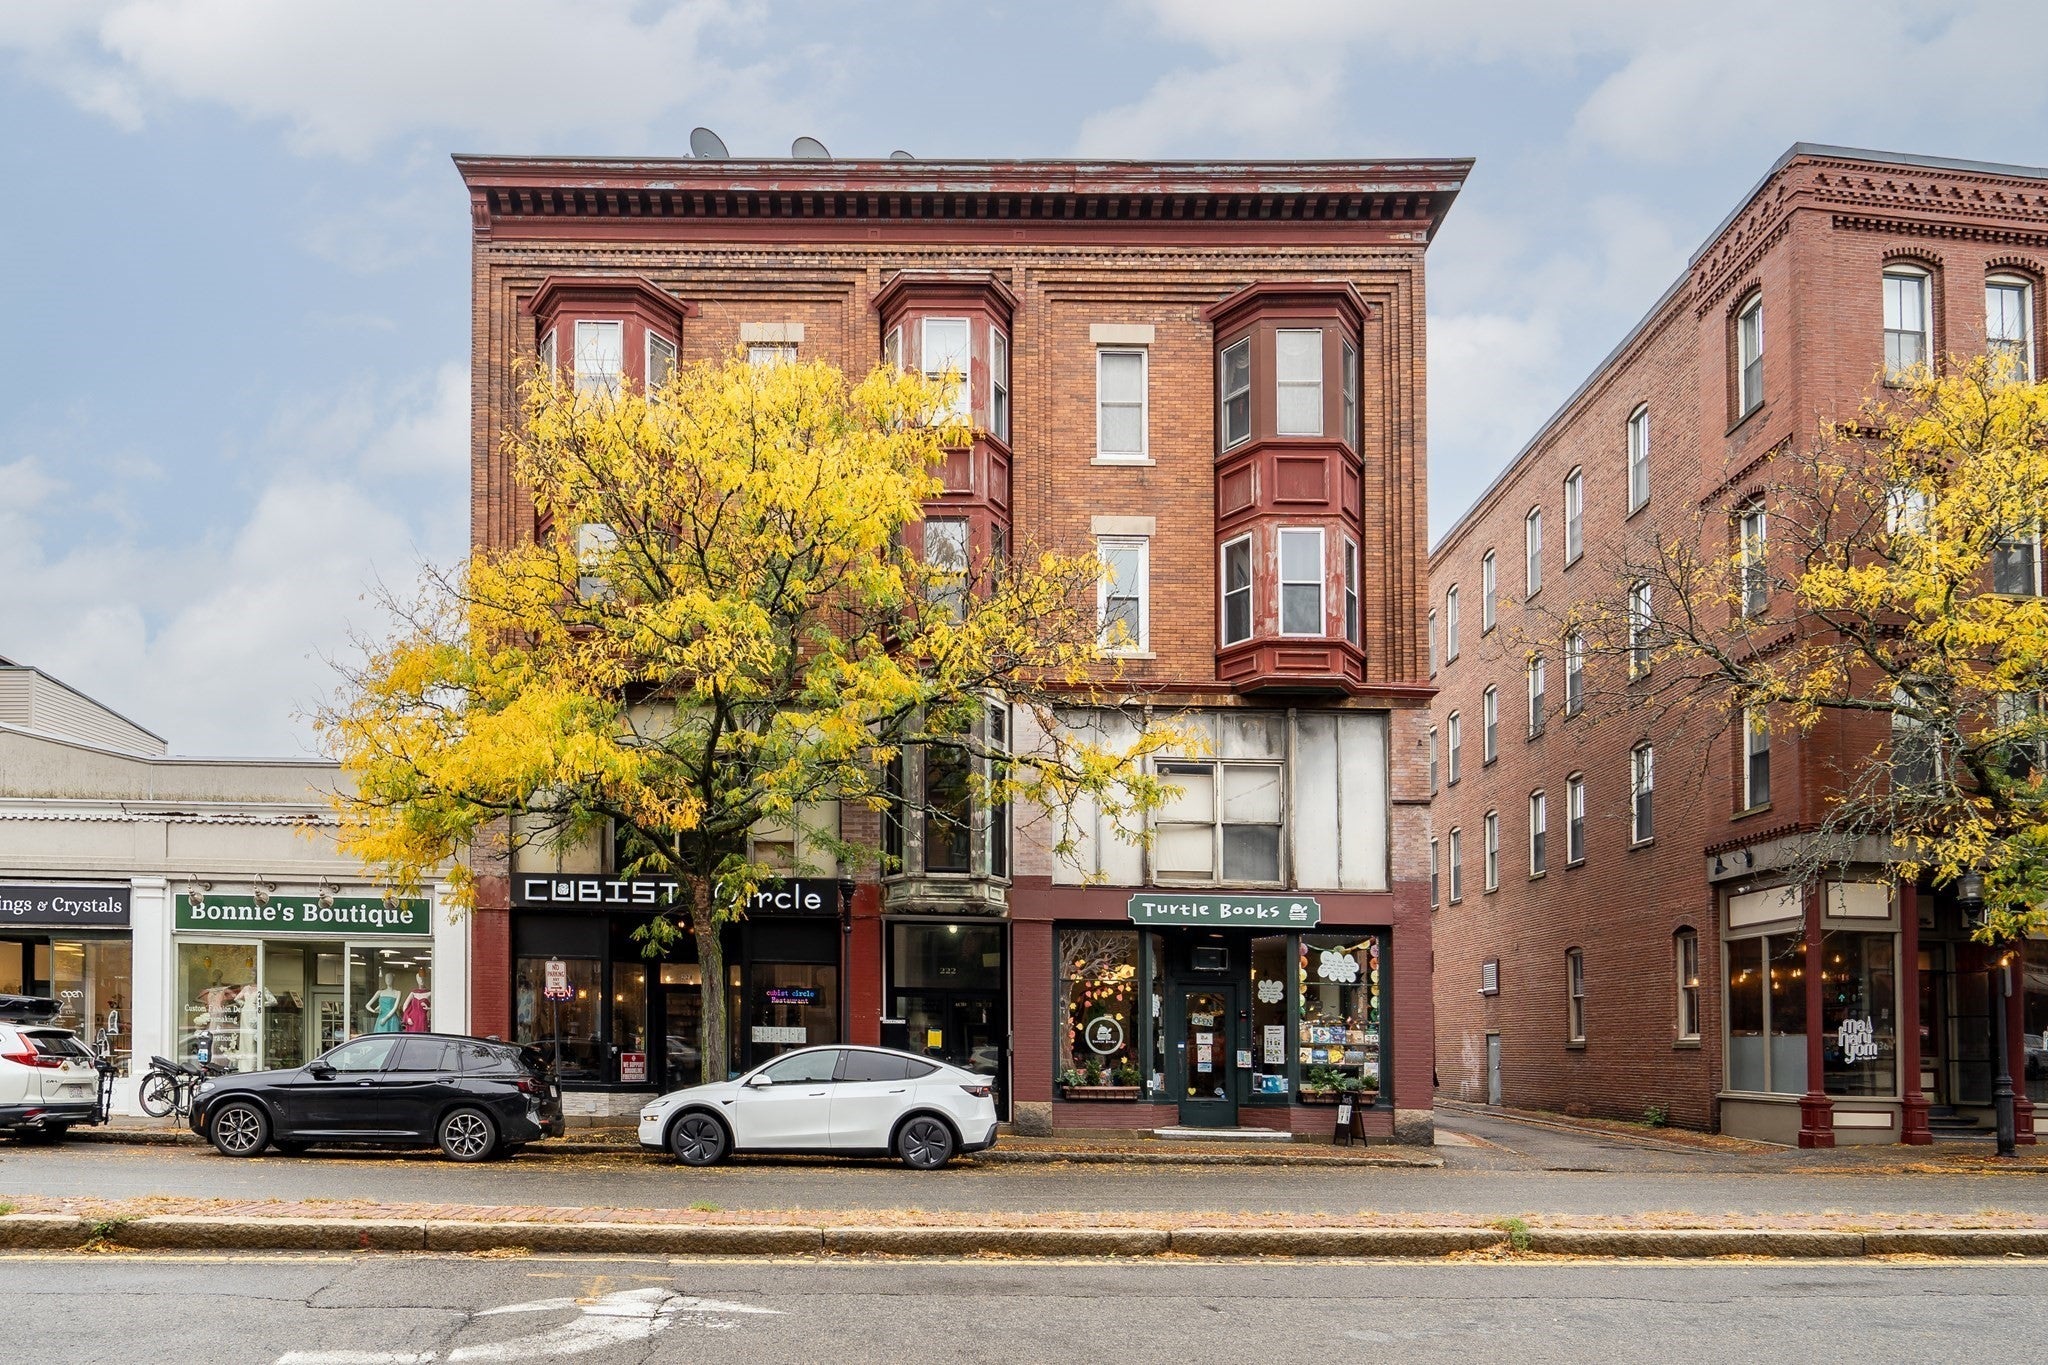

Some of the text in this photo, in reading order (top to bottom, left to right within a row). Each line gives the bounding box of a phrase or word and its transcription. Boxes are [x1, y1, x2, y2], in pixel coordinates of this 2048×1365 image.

[525, 880, 679, 904] CUBIST
[37, 901, 48, 911] &
[52, 897, 122, 916] Crystals
[1142, 903, 1280, 918] Turtle Books
[190, 902, 414, 927] Bonnie's Boutique
[60, 990, 84, 1003] open
[766, 989, 789, 997] cubist
[1193, 1016, 1213, 1026] OPEN
